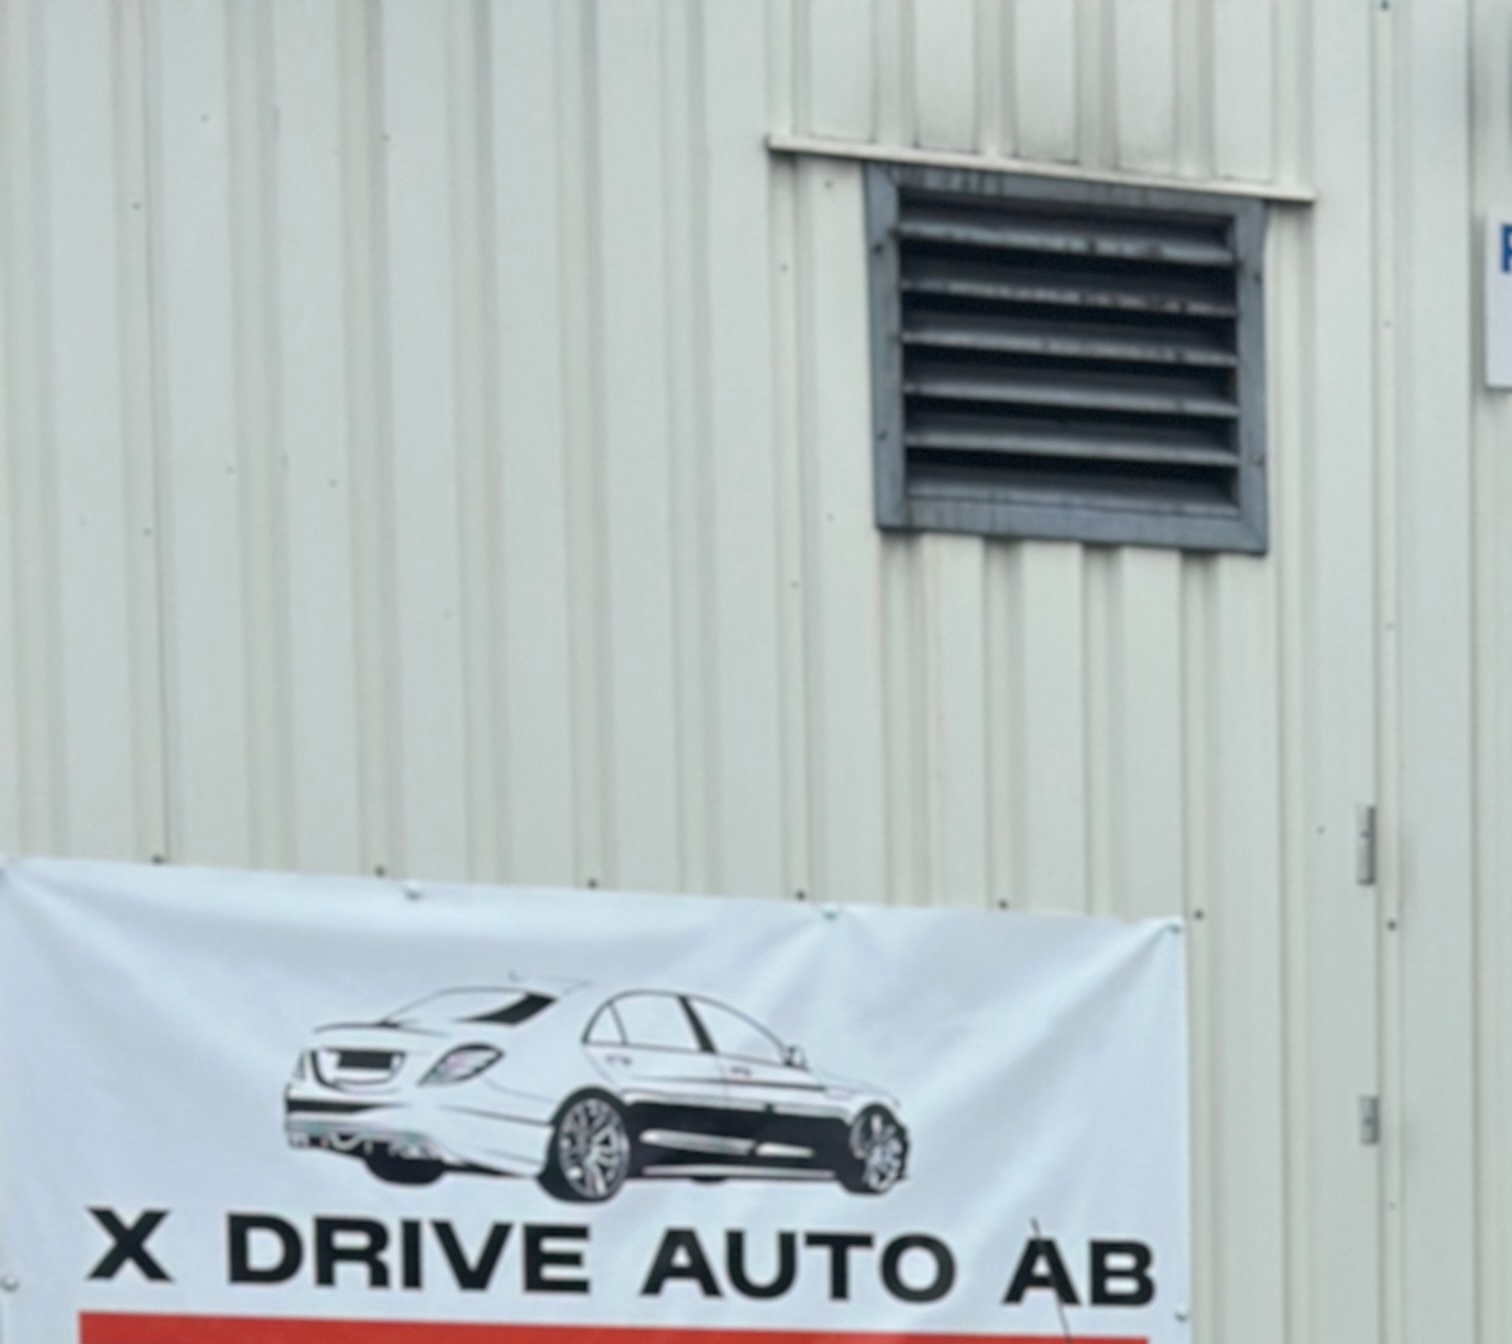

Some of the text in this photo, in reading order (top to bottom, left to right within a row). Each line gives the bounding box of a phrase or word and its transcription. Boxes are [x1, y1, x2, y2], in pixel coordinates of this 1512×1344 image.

[88, 1207, 1157, 1308] X DRIVE AUTO AB
